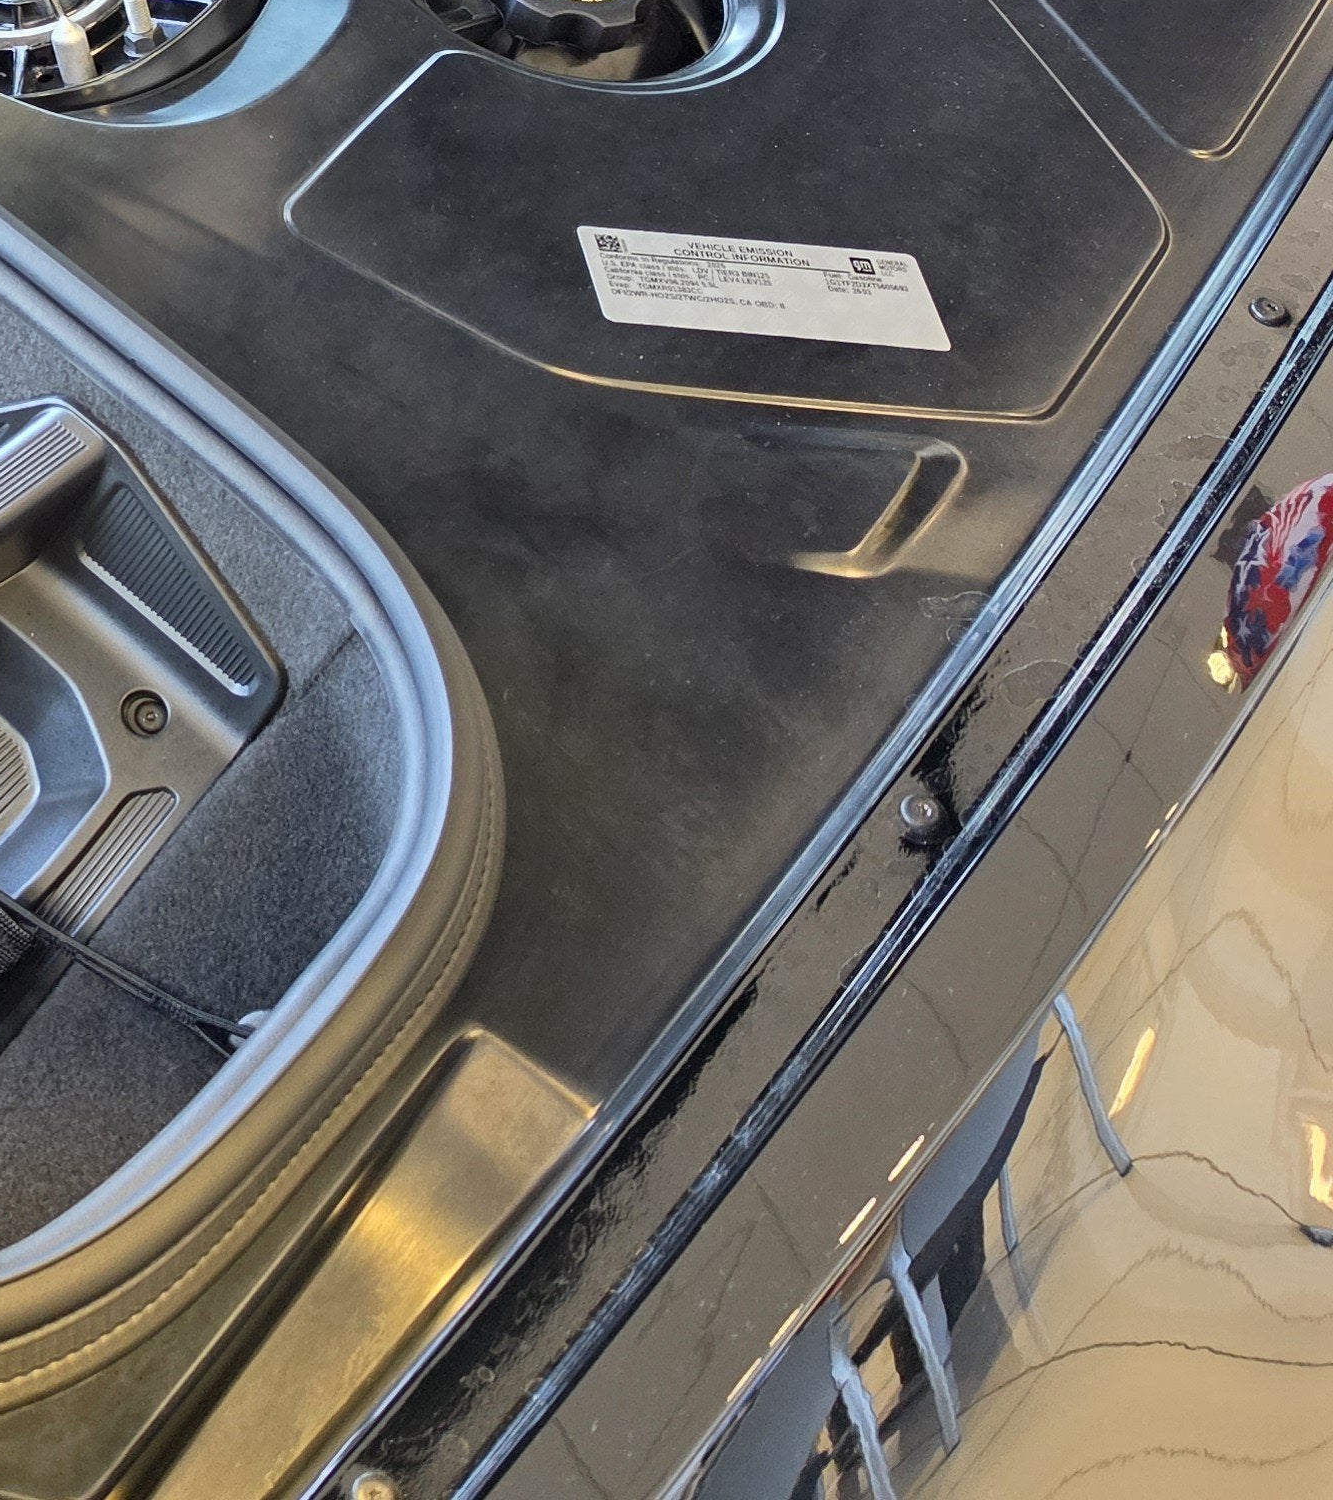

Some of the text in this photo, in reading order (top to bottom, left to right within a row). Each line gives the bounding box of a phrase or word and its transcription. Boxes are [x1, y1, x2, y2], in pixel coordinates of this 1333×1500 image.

[686, 242, 794, 257] VEHICLE EMISSION
[599, 253, 639, 262] Conforms
[674, 248, 810, 266] CONTROL INFORMATION
[604, 266, 643, 275] California
[691, 266, 709, 274] LDV
[716, 268, 740, 277] TIER3
[847, 273, 883, 282] Gasoline
